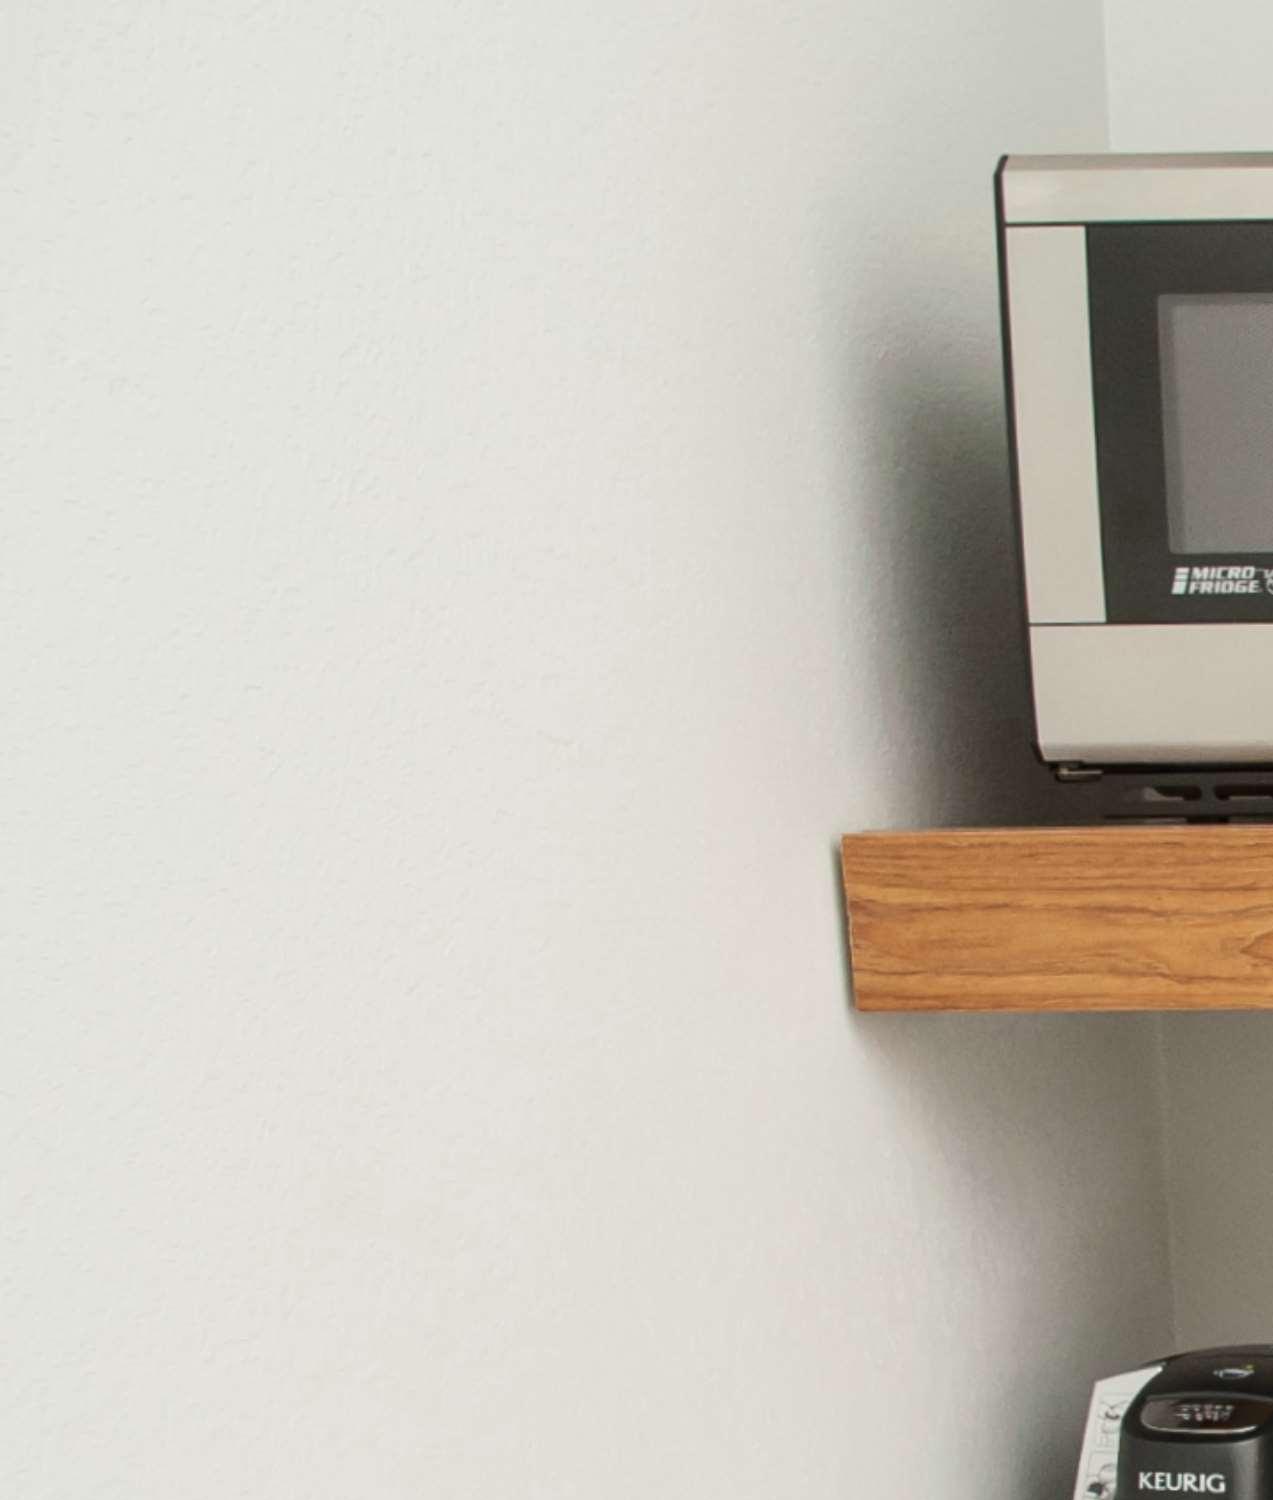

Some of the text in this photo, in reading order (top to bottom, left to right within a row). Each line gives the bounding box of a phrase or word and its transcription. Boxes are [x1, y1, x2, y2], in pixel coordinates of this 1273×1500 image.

[1191, 567, 1256, 580] MICRO
[1188, 580, 1259, 594] FRIDGE
[1138, 1471, 1226, 1493] KEURIG
